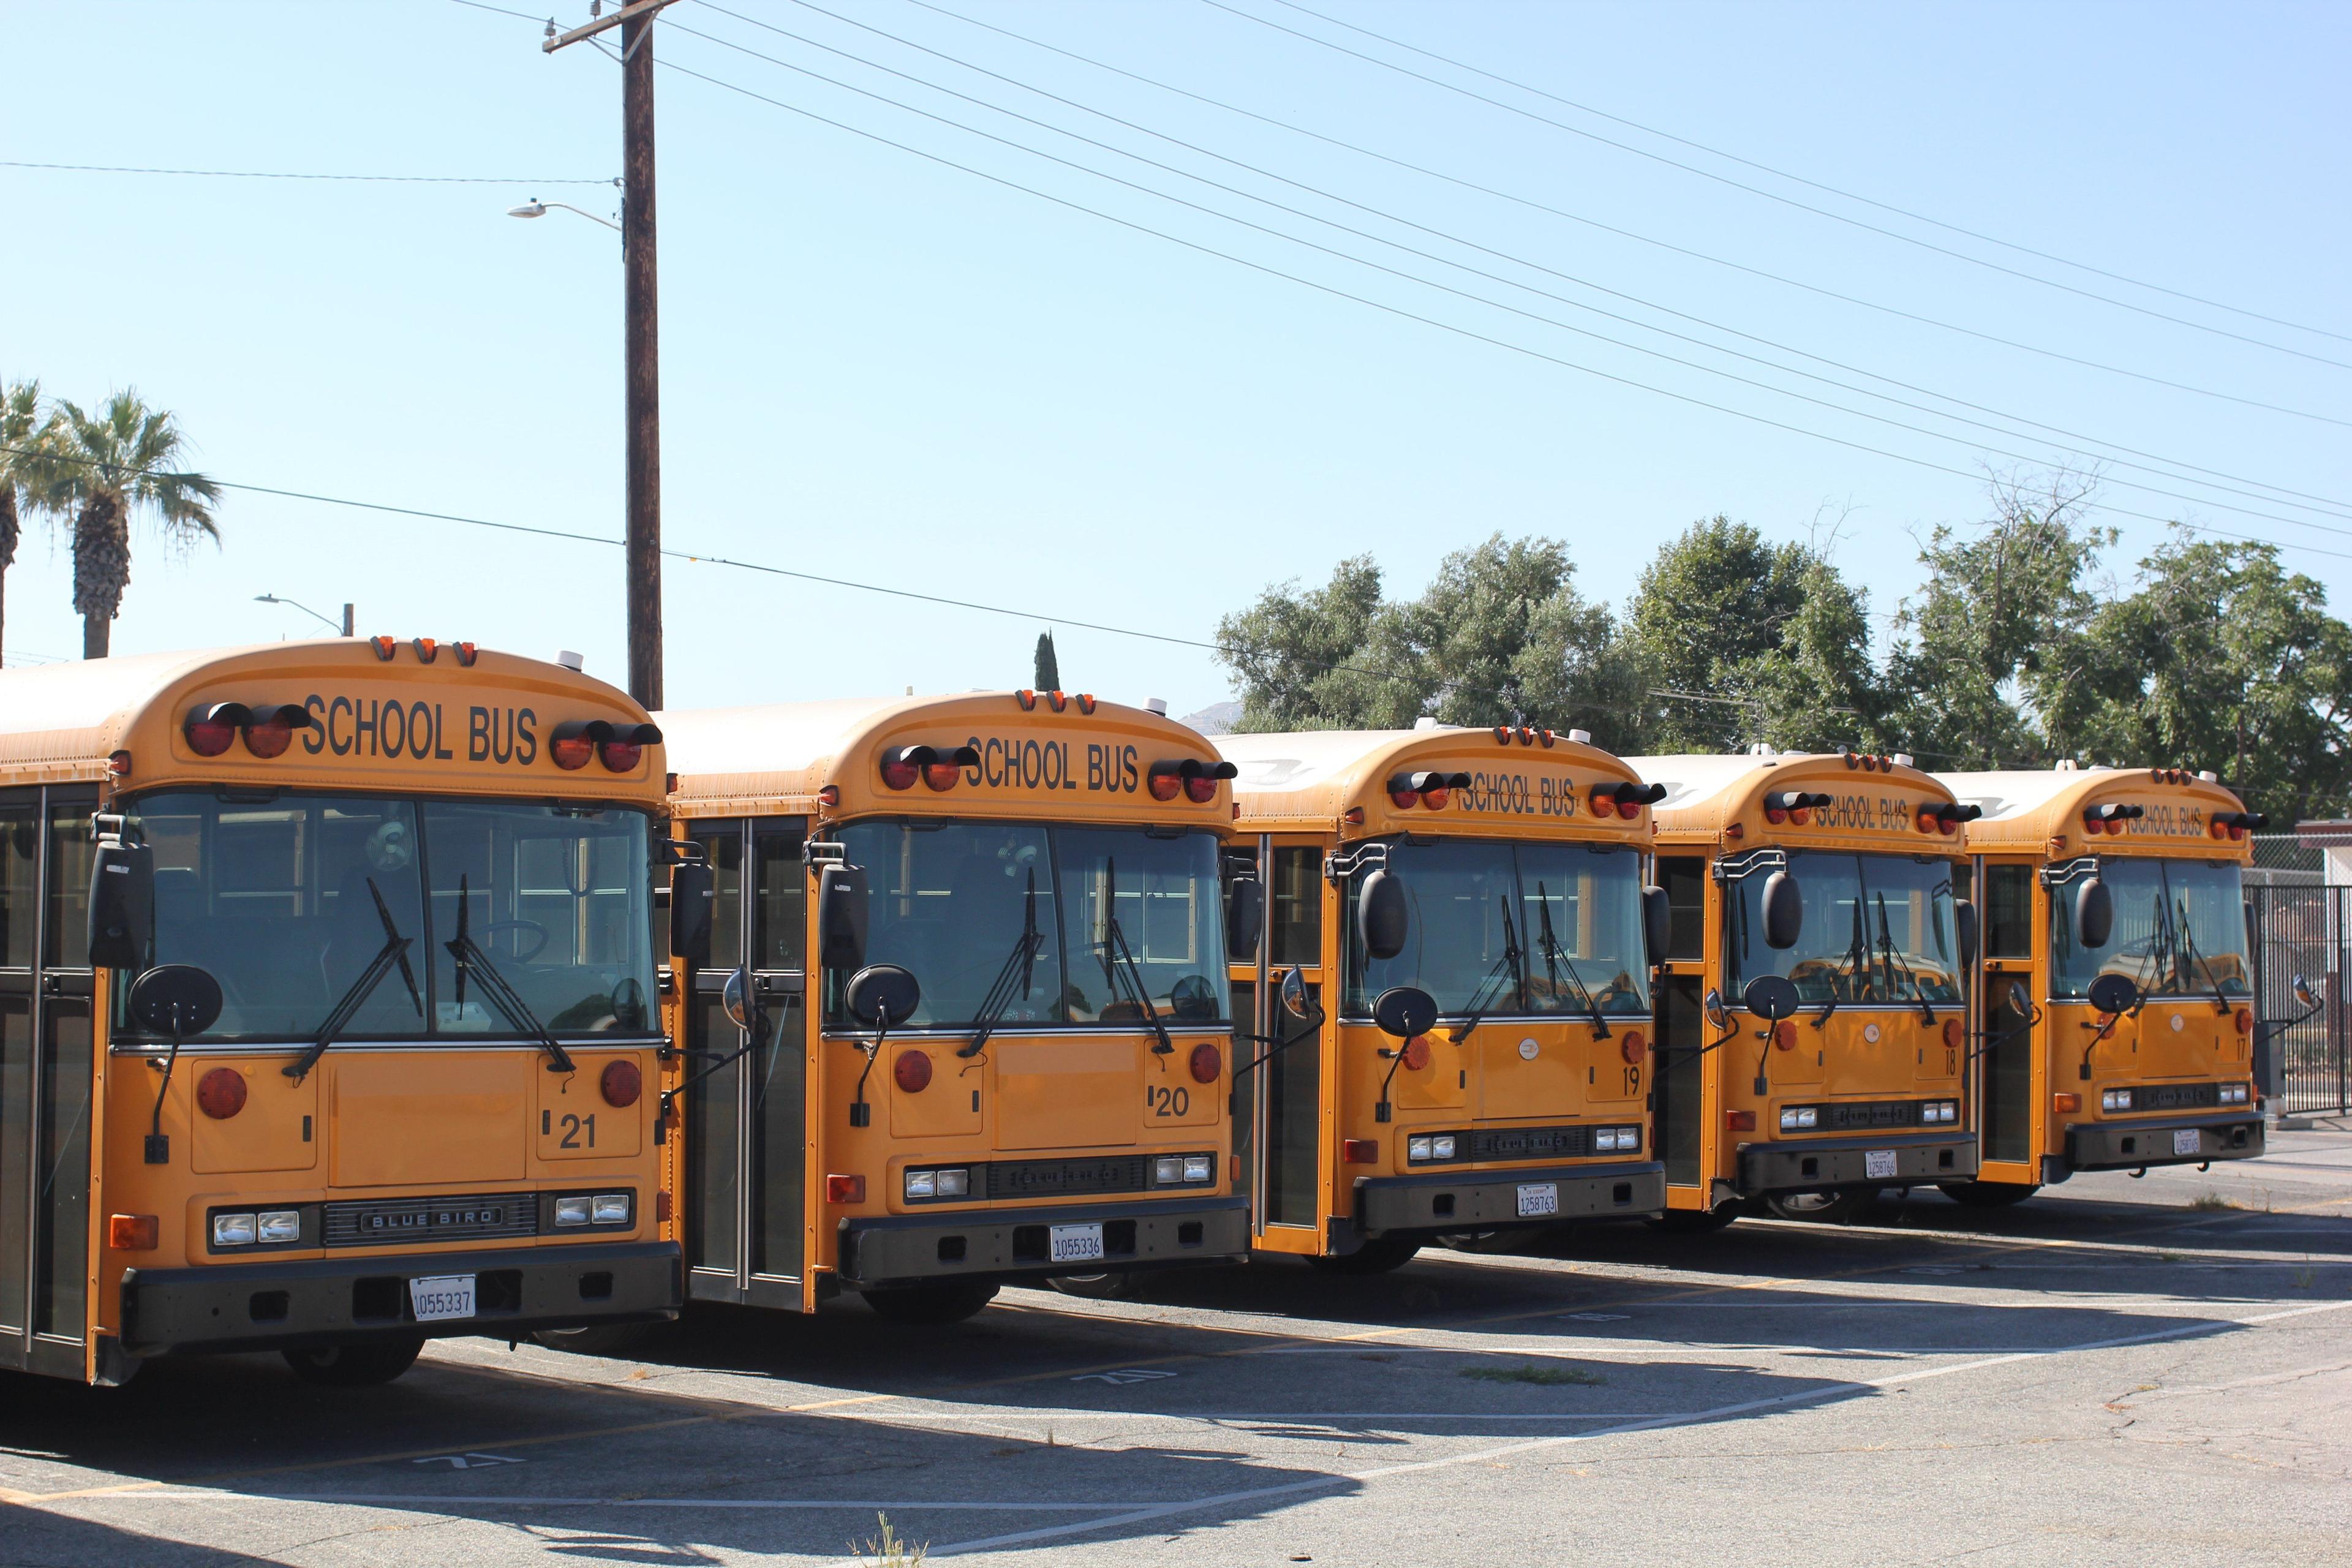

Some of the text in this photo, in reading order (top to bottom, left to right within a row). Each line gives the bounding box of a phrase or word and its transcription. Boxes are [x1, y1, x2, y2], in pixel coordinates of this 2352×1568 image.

[302, 695, 537, 766] SCHOOL BUS
[965, 736, 1138, 793] SCHOOL BUS
[1463, 771, 1574, 816] SCHOOL BUS
[1880, 799, 1907, 831] BUS
[2179, 806, 2201, 836] BUS
[1946, 1049, 1956, 1076] 18
[2237, 1038, 2246, 1061] 17
[1623, 1066, 1640, 1096] 19
[1156, 1087, 1189, 1117] 20
[560, 1114, 595, 1149] 21
[1869, 1161, 1894, 1174] 1258766
[1521, 1196, 1555, 1212] 1258763
[372, 1212, 491, 1227] BLUE BIRD
[1055, 1237, 1100, 1256] 1055336
[415, 1291, 470, 1315] 1055337
